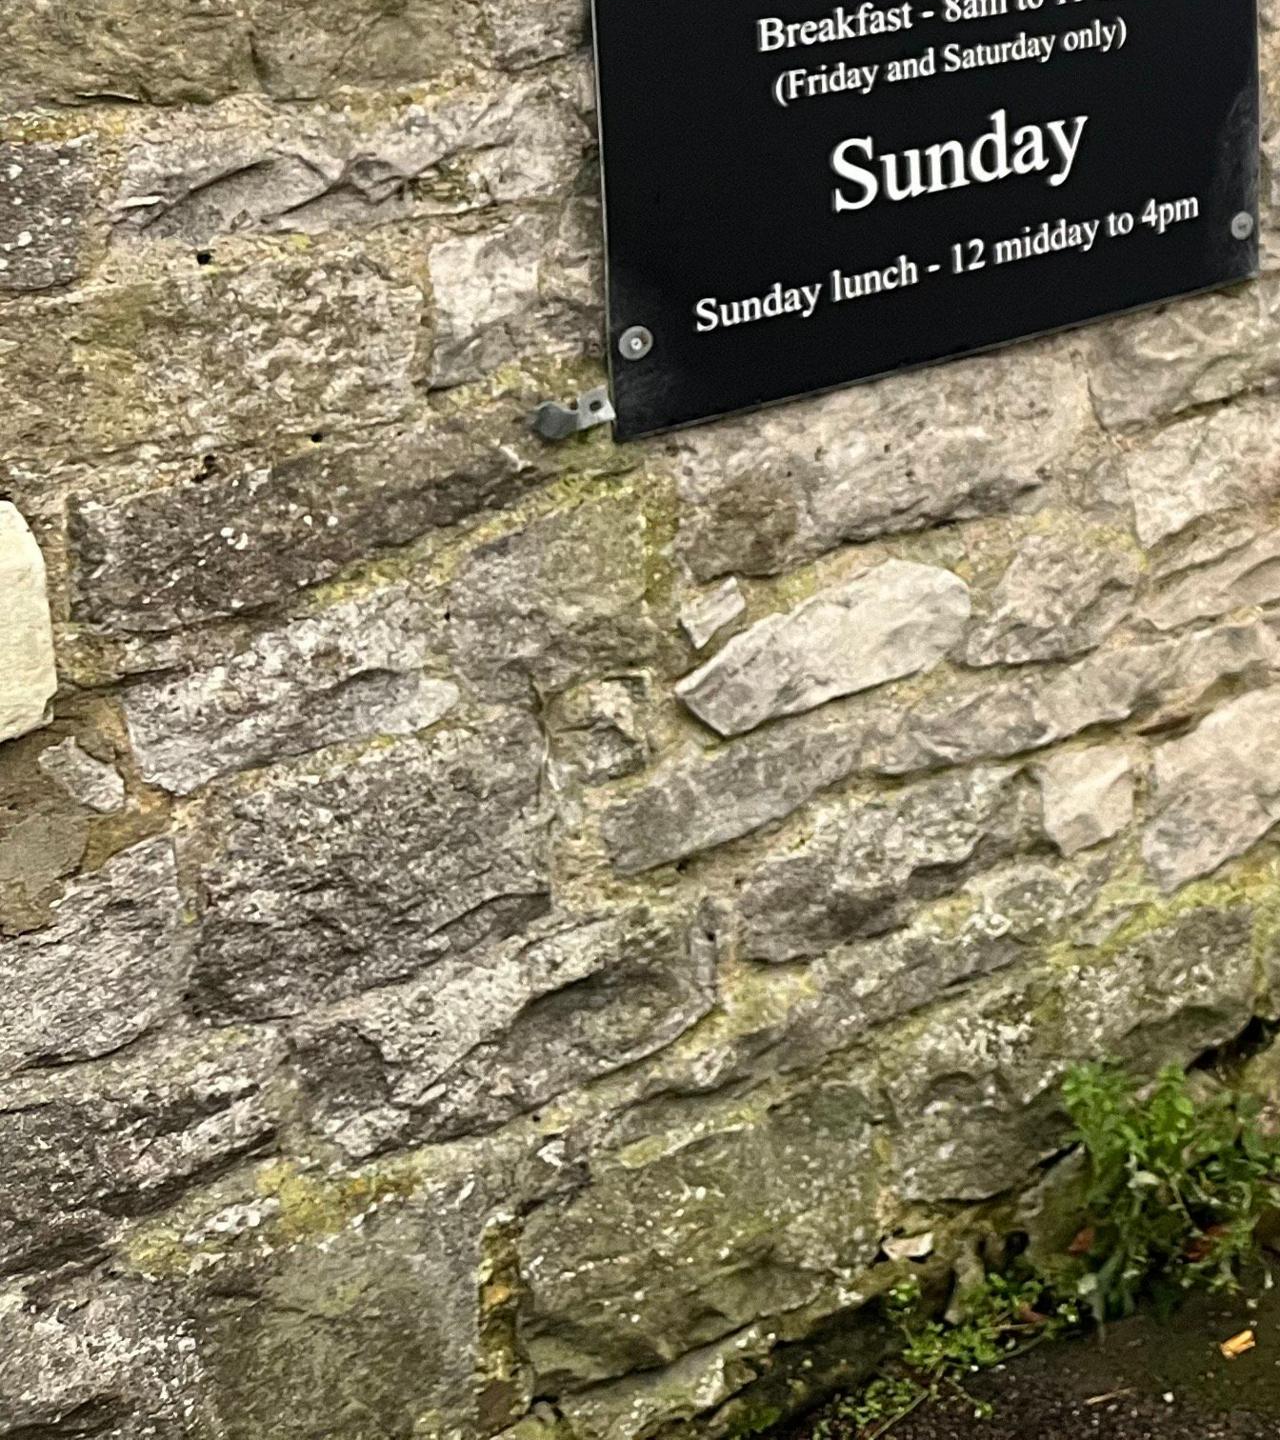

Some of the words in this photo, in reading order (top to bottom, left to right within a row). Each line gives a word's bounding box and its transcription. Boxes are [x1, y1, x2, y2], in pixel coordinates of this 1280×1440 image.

[757, 1, 913, 52] Breakfast
[775, 61, 879, 107] (Friday
[886, 46, 936, 82] and
[943, 31, 1056, 72] Saturday
[1063, 17, 1127, 53] only)
[832, 108, 1089, 213] Sunday
[696, 282, 822, 332] Sunday
[832, 254, 918, 302] lunch
[953, 238, 986, 274] 12
[995, 218, 1100, 265] midday
[1107, 212, 1134, 237] to
[1141, 196, 1199, 234] 4pm
